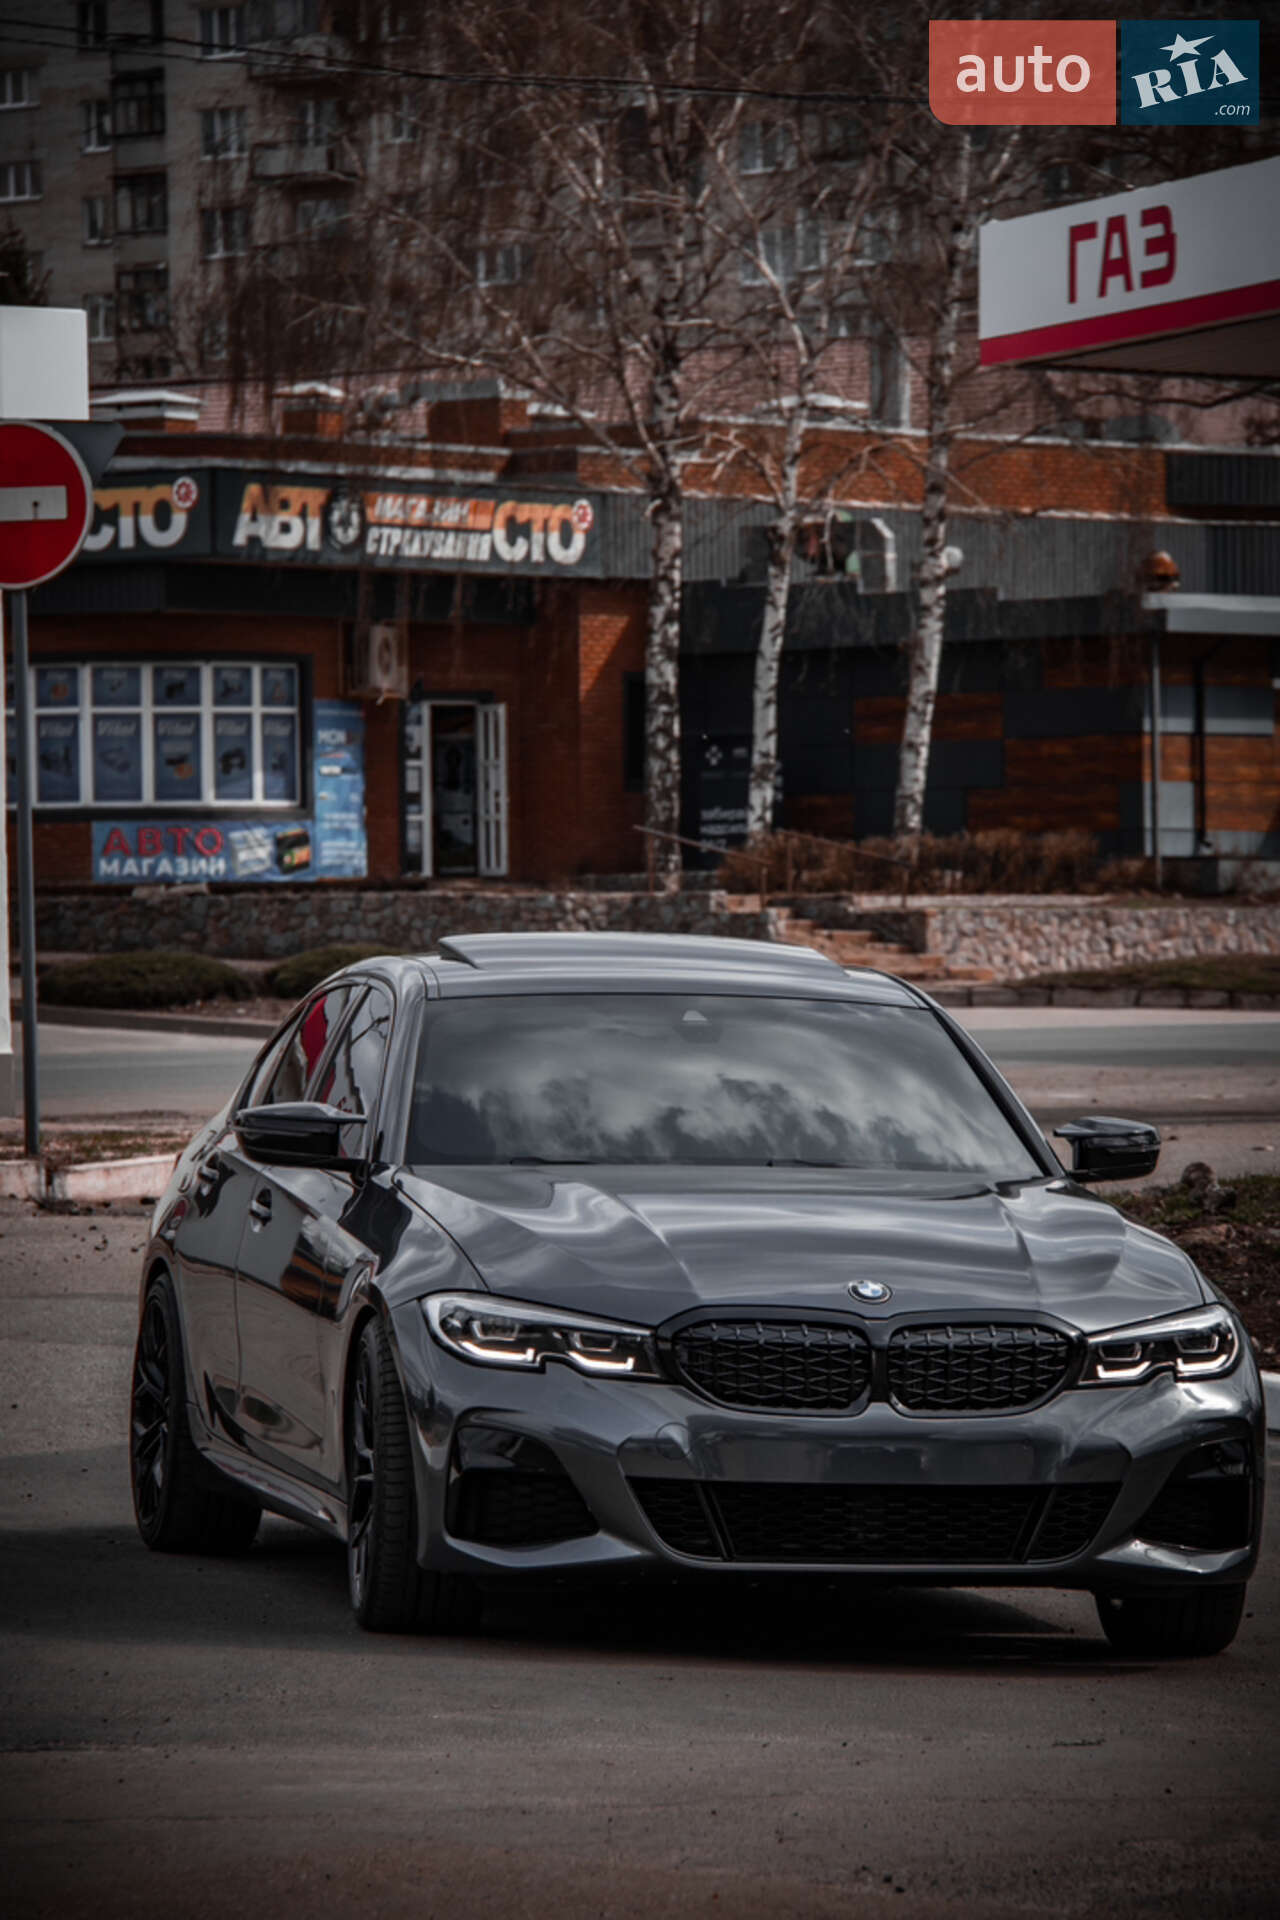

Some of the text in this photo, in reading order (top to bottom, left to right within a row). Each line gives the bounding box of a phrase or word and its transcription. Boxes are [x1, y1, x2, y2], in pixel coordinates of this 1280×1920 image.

[1068, 204, 1177, 304] ГАЗ
[82, 483, 188, 552] СТО
[492, 500, 588, 565] СТО
[99, 857, 227, 876] МАГАЗИН
[102, 827, 224, 857] АВТО
